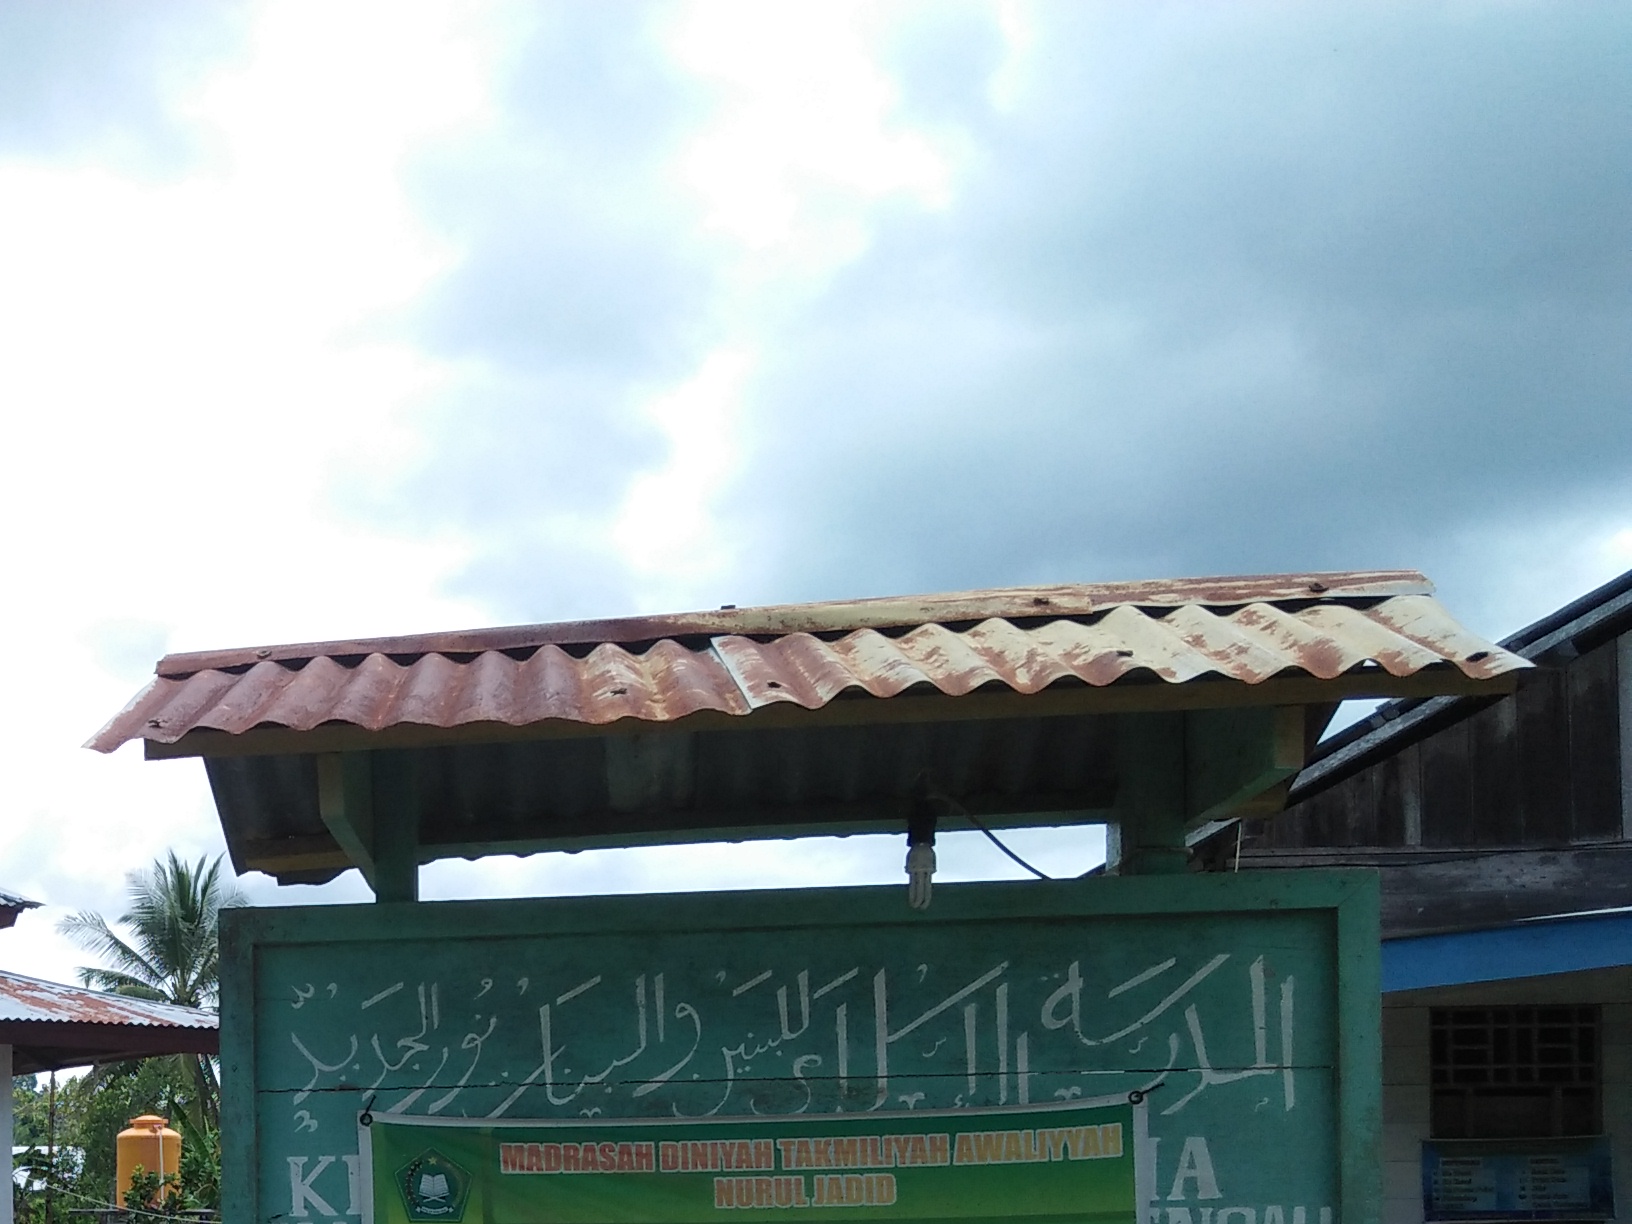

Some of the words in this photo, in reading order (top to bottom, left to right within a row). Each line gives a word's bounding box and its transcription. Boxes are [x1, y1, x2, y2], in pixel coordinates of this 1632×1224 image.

[499, 1142, 655, 1174] MADRASAH
[659, 1139, 775, 1172] DINIYAH
[776, 1133, 951, 1171] TAKMILIYAH
[952, 1123, 1123, 1166] AWALIYYAH
[714, 1175, 810, 1208] NURUL
[812, 1173, 897, 1208] JADID
